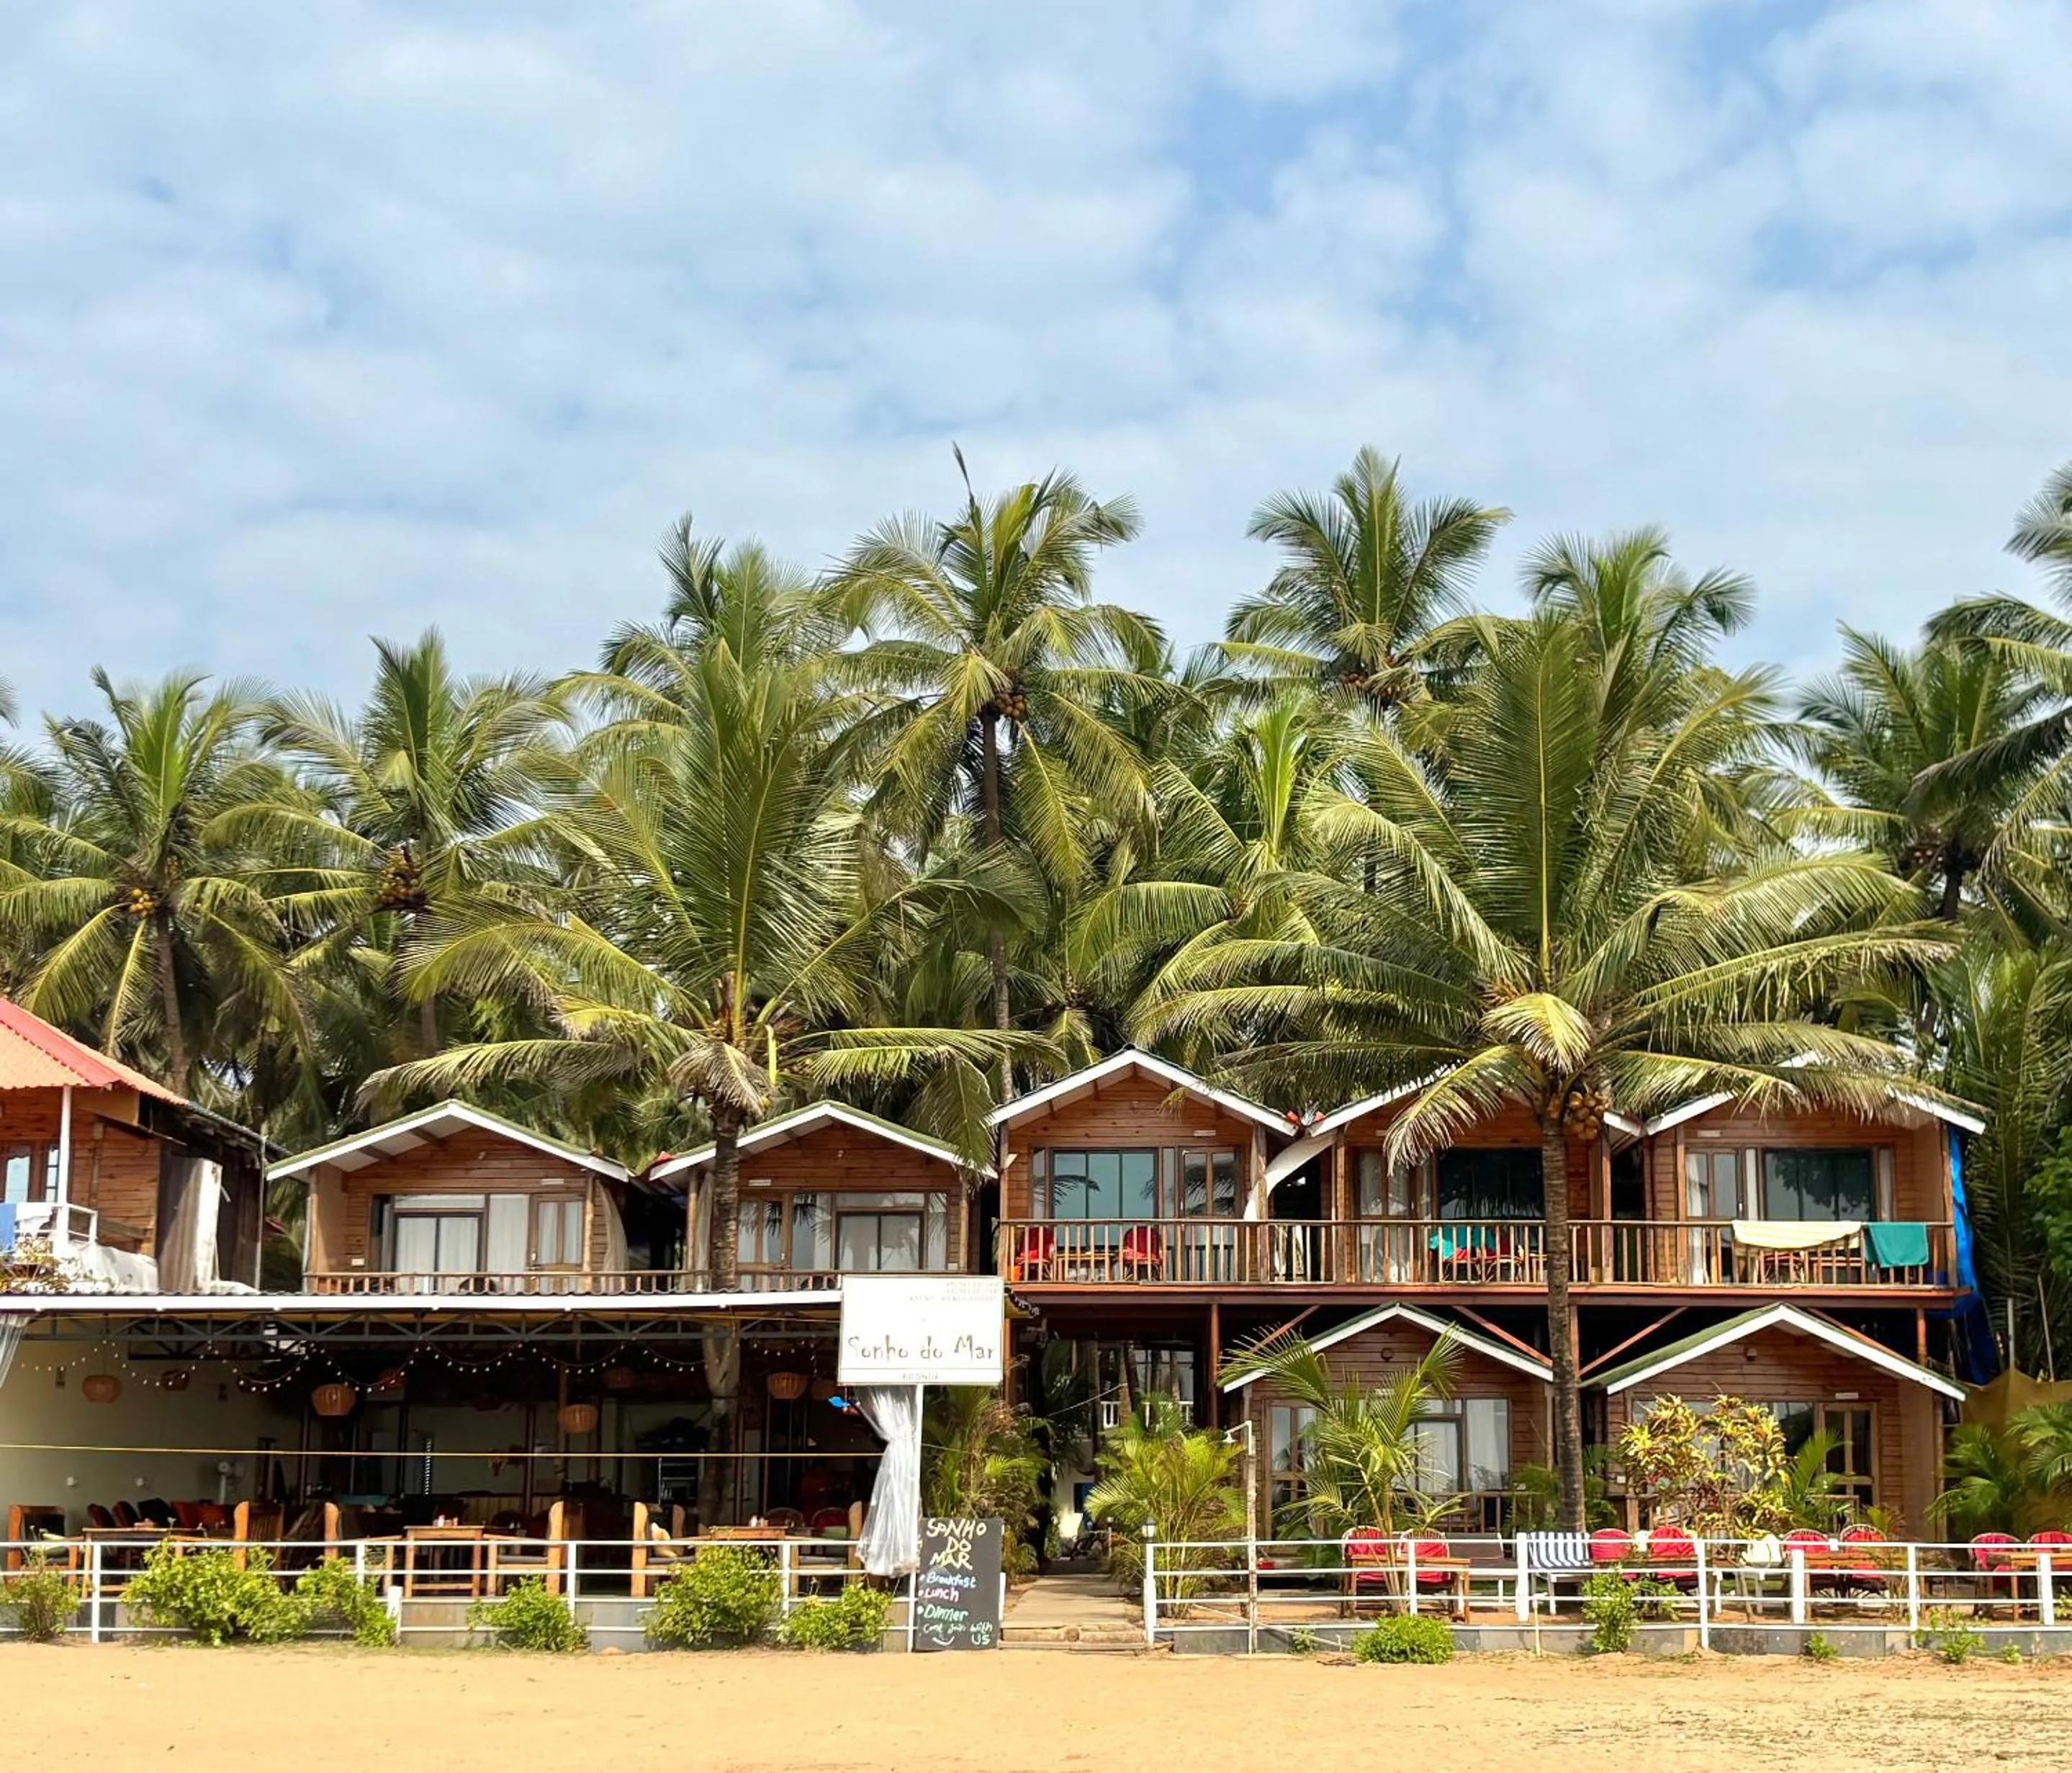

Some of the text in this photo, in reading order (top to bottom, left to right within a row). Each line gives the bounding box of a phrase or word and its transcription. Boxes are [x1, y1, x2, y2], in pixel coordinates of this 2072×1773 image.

[847, 1334, 995, 1361] Sonho do Mar
[945, 1535, 972, 1553] DO
[929, 1550, 973, 1571] MAR
[927, 1571, 977, 1589] Breakfast
[924, 1586, 960, 1603] Lunch
[924, 1603, 969, 1622] Dinner
